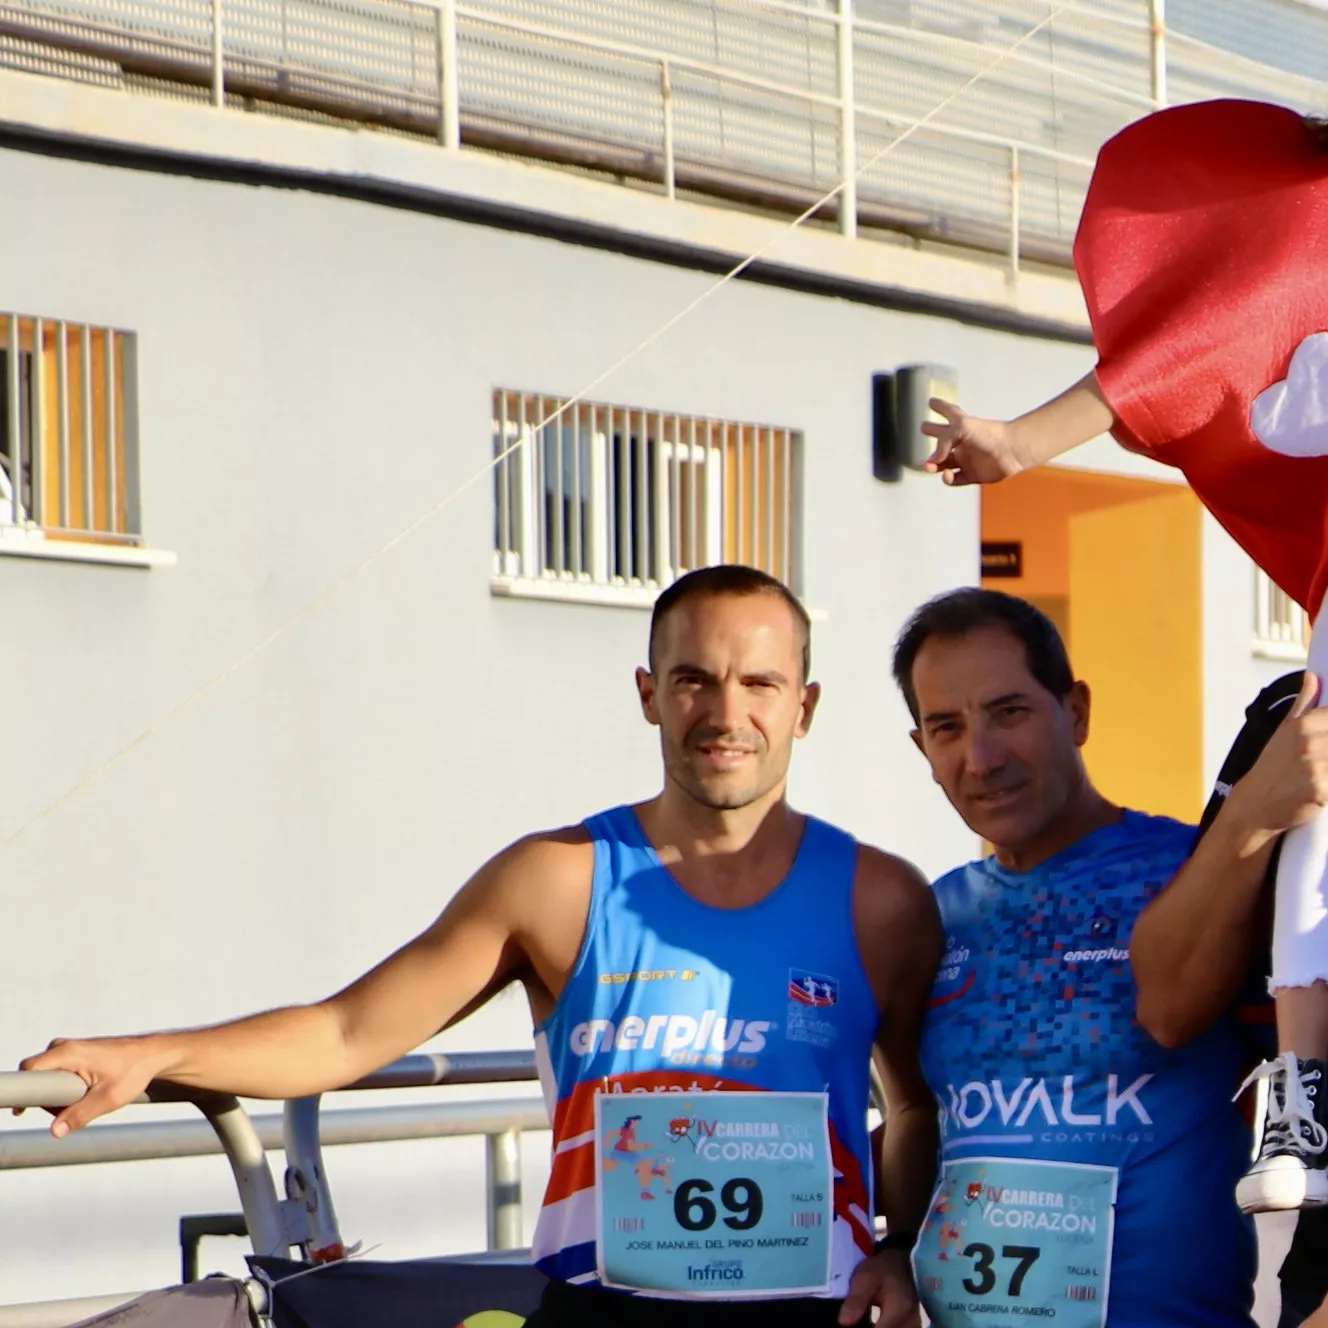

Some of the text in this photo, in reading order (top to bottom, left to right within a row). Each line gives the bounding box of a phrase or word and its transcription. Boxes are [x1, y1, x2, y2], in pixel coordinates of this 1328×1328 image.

[570, 1010, 771, 1057] enerplus
[670, 1050, 758, 1069] directo
[716, 1121, 780, 1139] CARRERA
[673, 1177, 764, 1231] 69
[1002, 1188, 1063, 1208] CARRERA
[625, 1237, 808, 1250] JOSE MANUEL DEL PINO MARTINEZ
[688, 1264, 744, 1280] Infrico
[962, 1242, 1041, 1297] 37
[968, 1302, 1009, 1315] CABRERA
[1012, 1305, 1056, 1318] ROMERO
